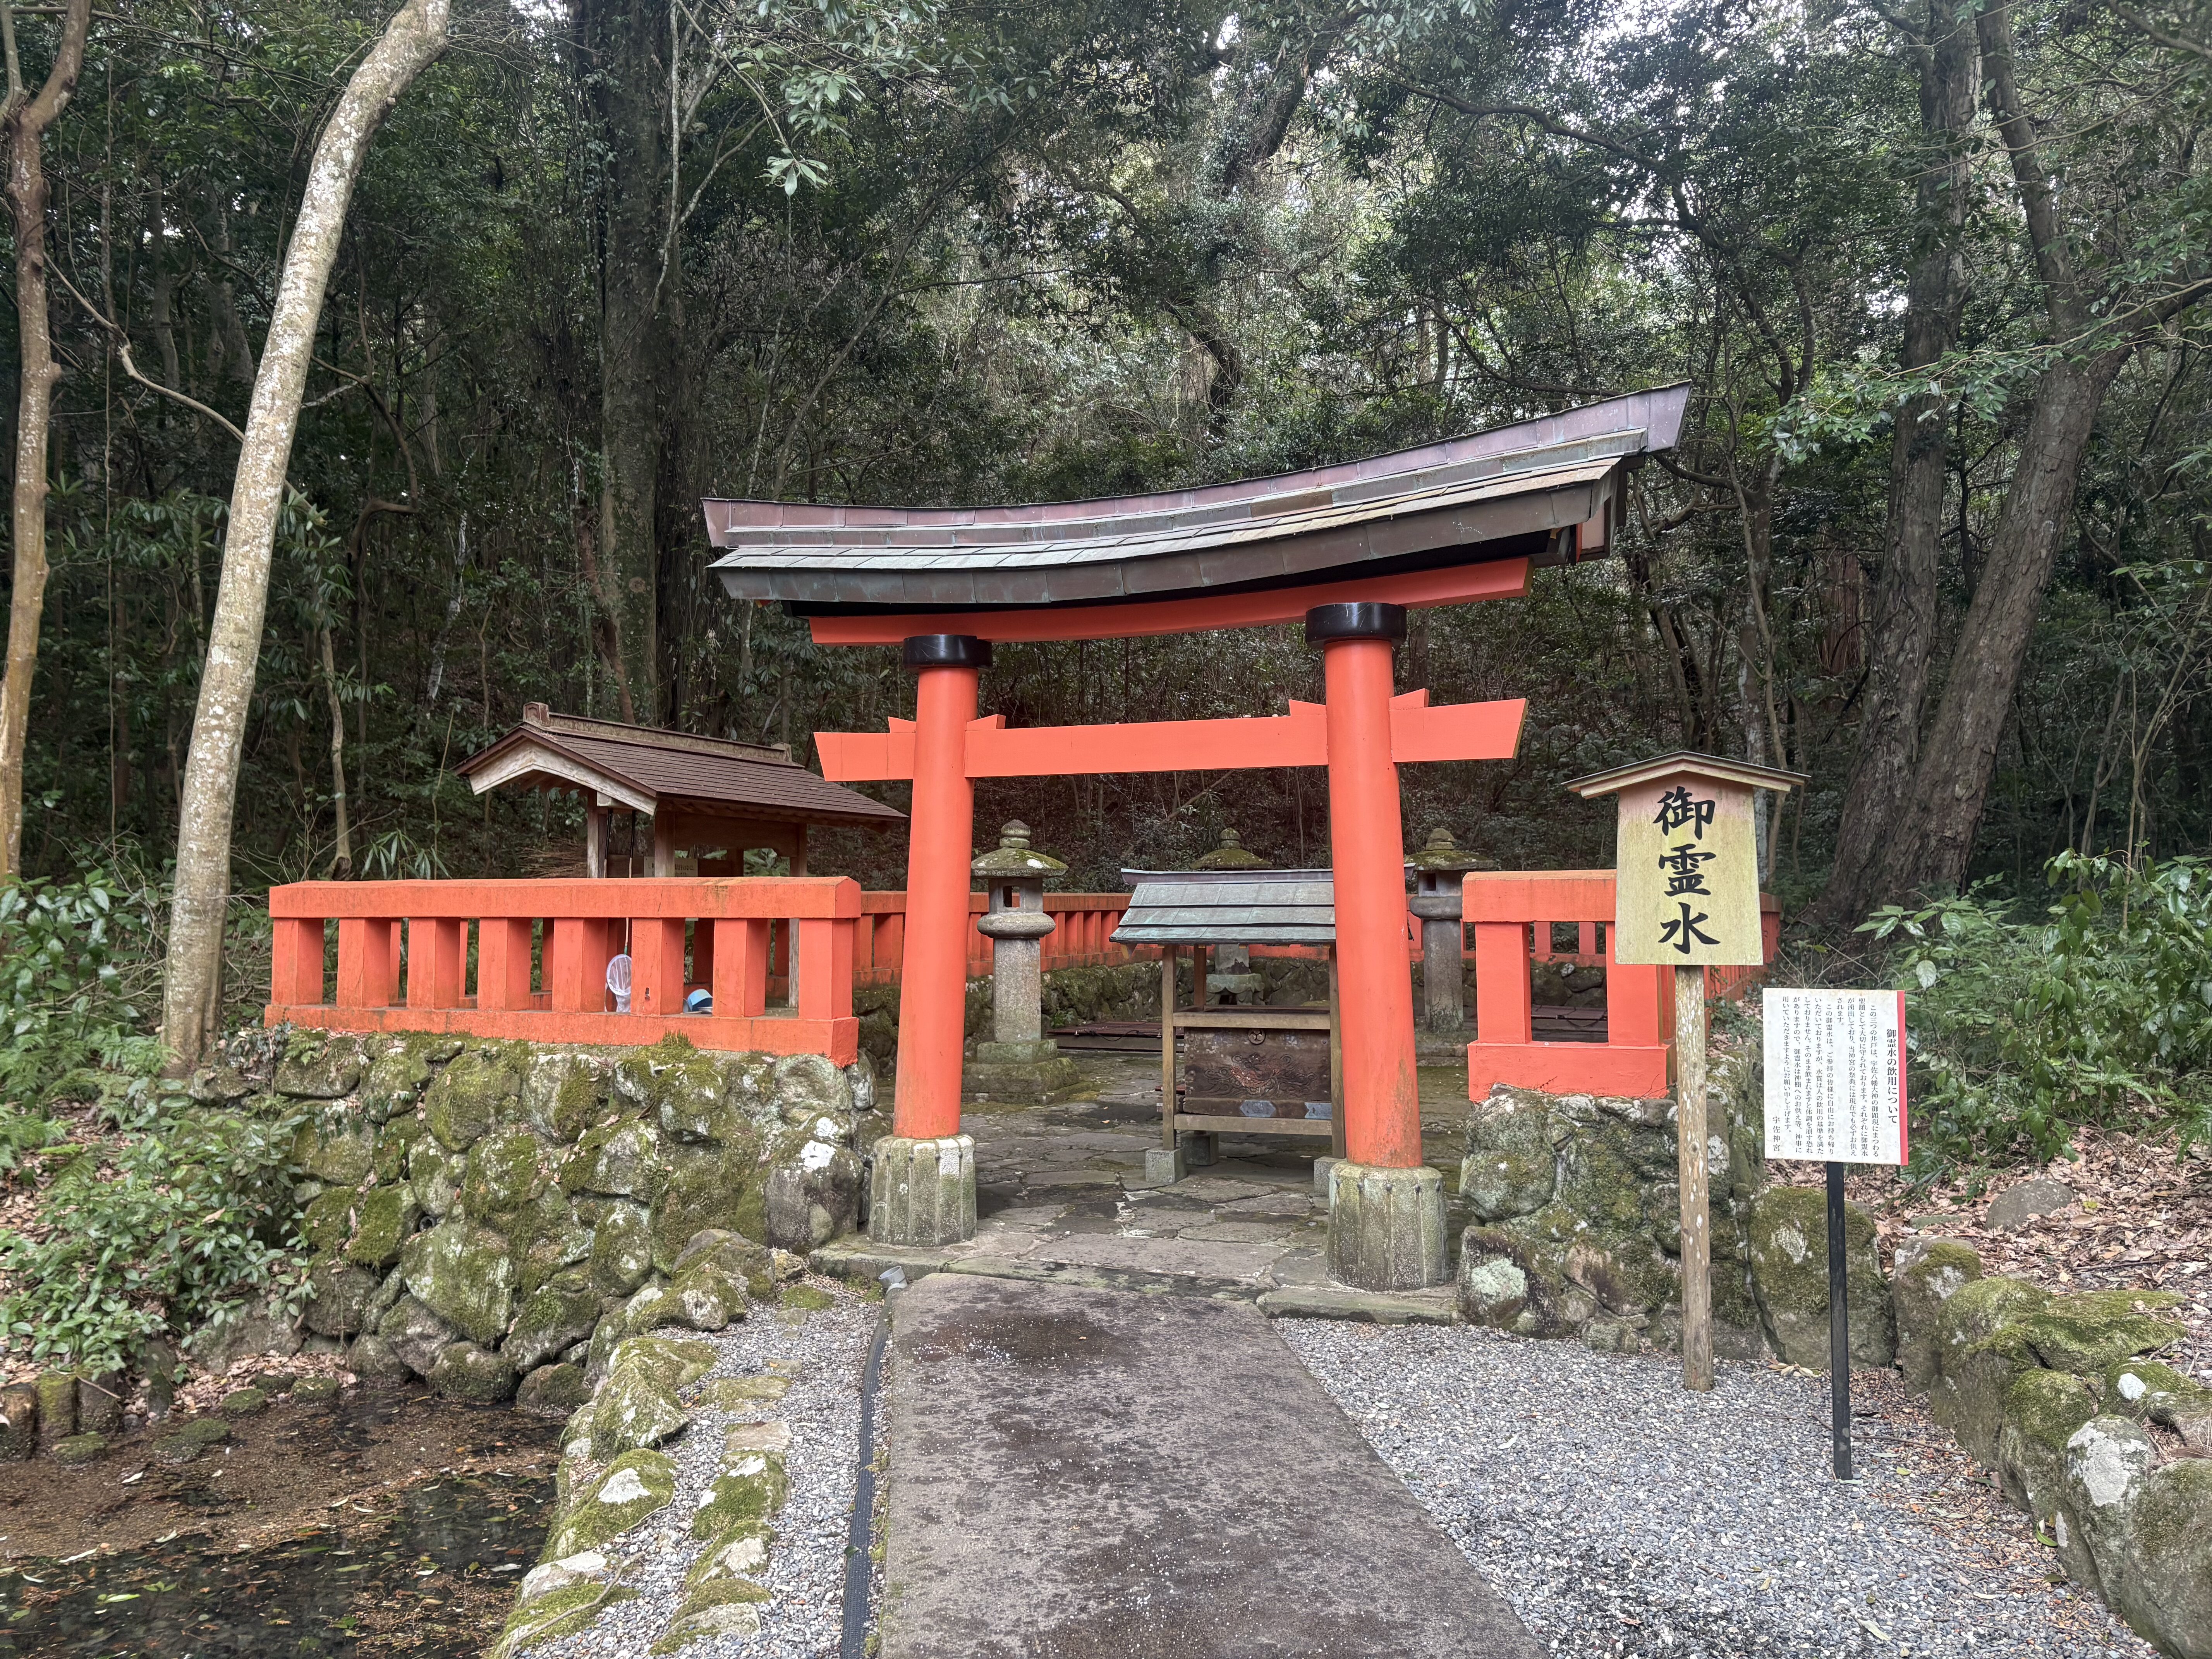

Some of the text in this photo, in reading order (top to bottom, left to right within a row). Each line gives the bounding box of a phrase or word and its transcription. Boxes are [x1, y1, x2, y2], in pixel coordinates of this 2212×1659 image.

[1653, 786, 1721, 954] 御霊水
[1886, 1029, 1898, 1123] 御霊水の飲用について
